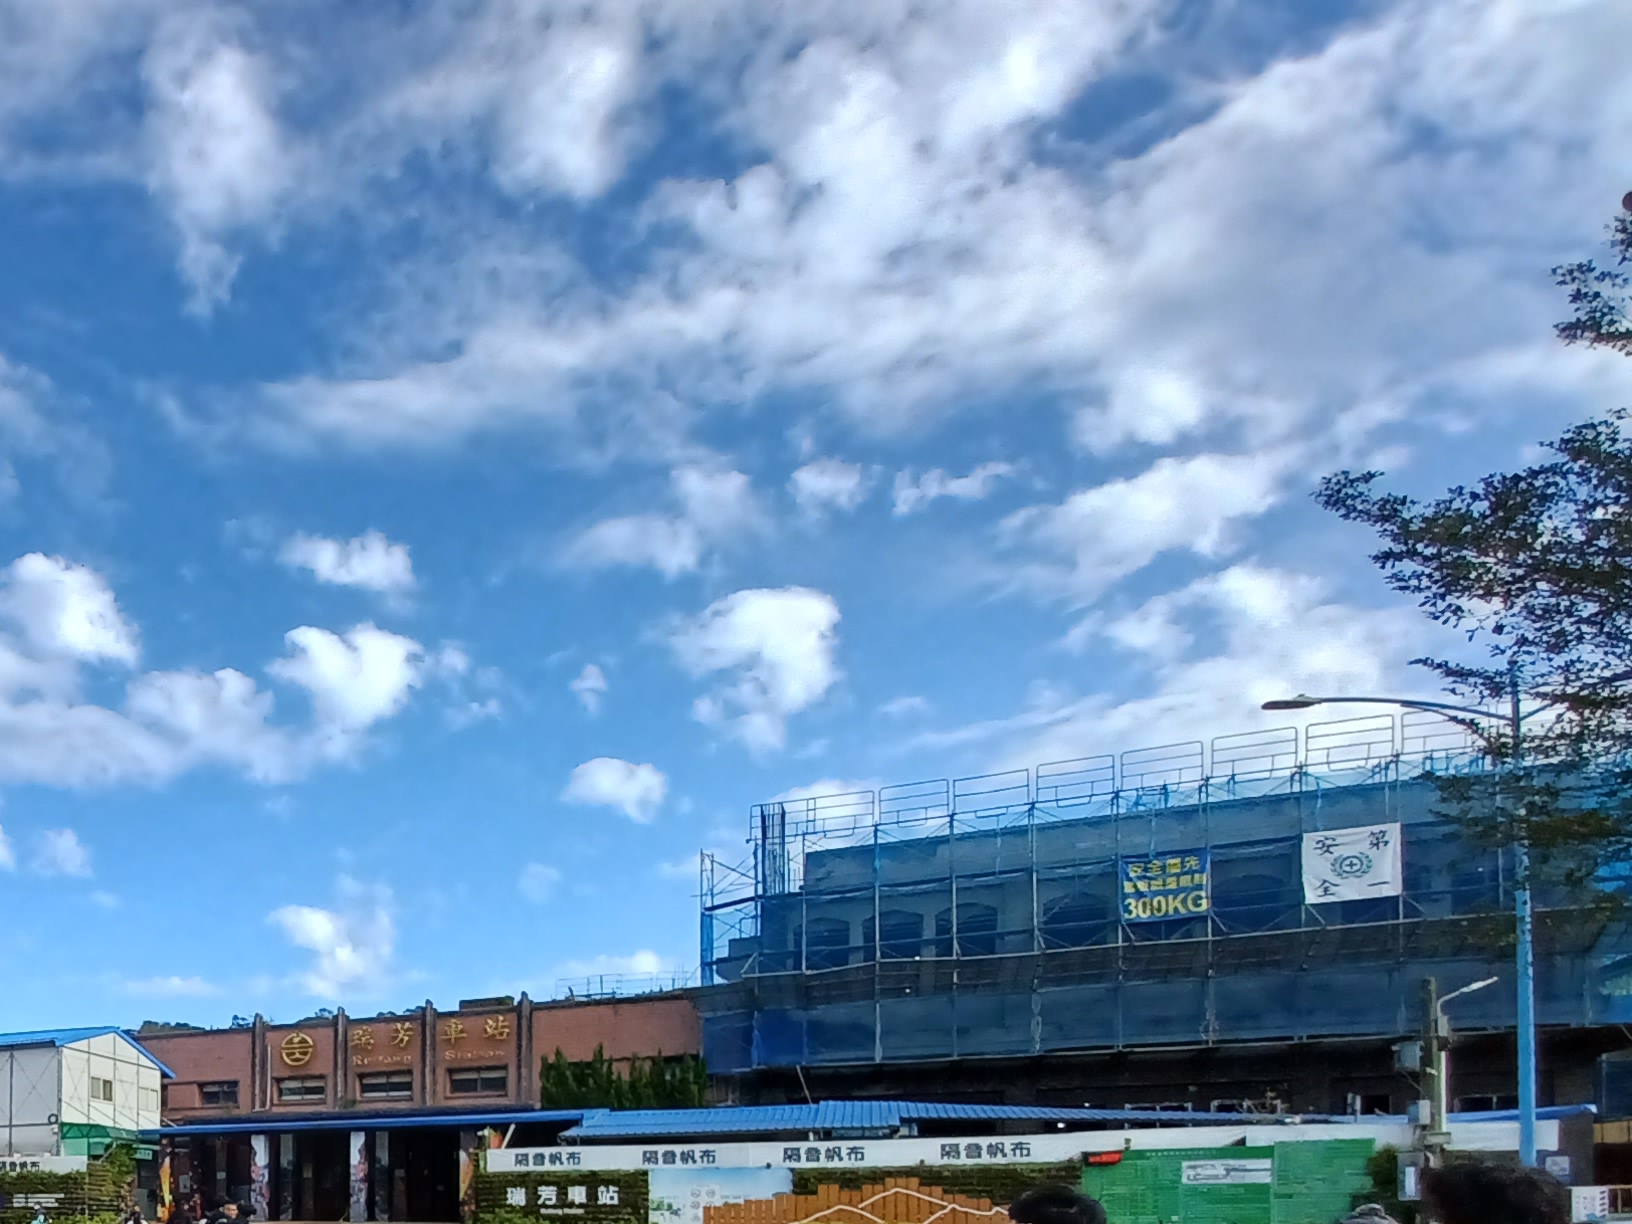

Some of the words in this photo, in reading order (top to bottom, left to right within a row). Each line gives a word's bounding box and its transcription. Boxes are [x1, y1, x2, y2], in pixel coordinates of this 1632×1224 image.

[1124, 891, 1209, 919] 300KG
[350, 1015, 511, 1050] 瑞芳車站
[514, 1151, 582, 1167] 隔音帆布
[642, 1149, 716, 1165] 隔音帆布
[782, 1146, 865, 1163] 隔音帆布
[940, 1141, 1032, 1160] 隔音帆布
[506, 1185, 620, 1207] 瑞芳車站
